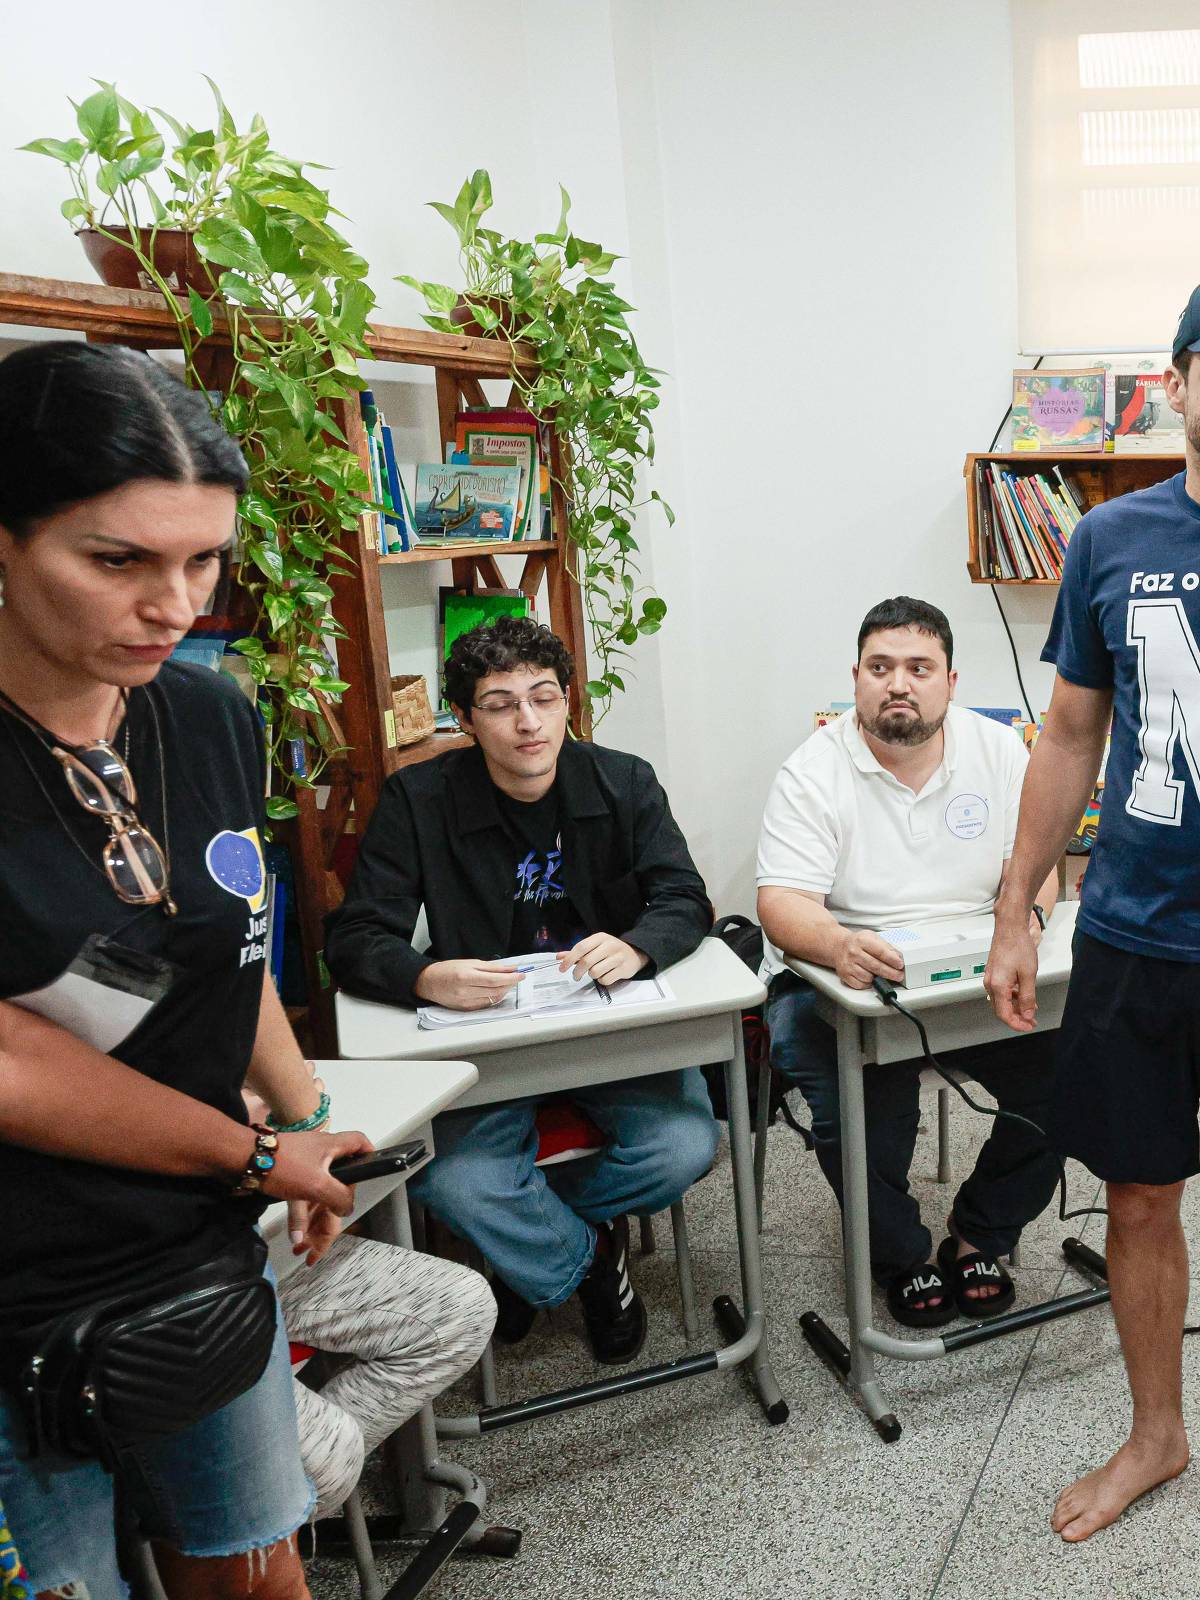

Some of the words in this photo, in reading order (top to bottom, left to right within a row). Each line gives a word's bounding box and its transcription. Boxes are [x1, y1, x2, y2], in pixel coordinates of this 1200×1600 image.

[1136, 378, 1163, 387] FÁBULA
[1040, 406, 1079, 416] RUSSAS
[486, 437, 527, 450] Impostos
[1129, 572, 1175, 593] Faz
[1181, 574, 1199, 592] o
[960, 1261, 1001, 1279] FILA
[902, 1274, 943, 1298] FILA
